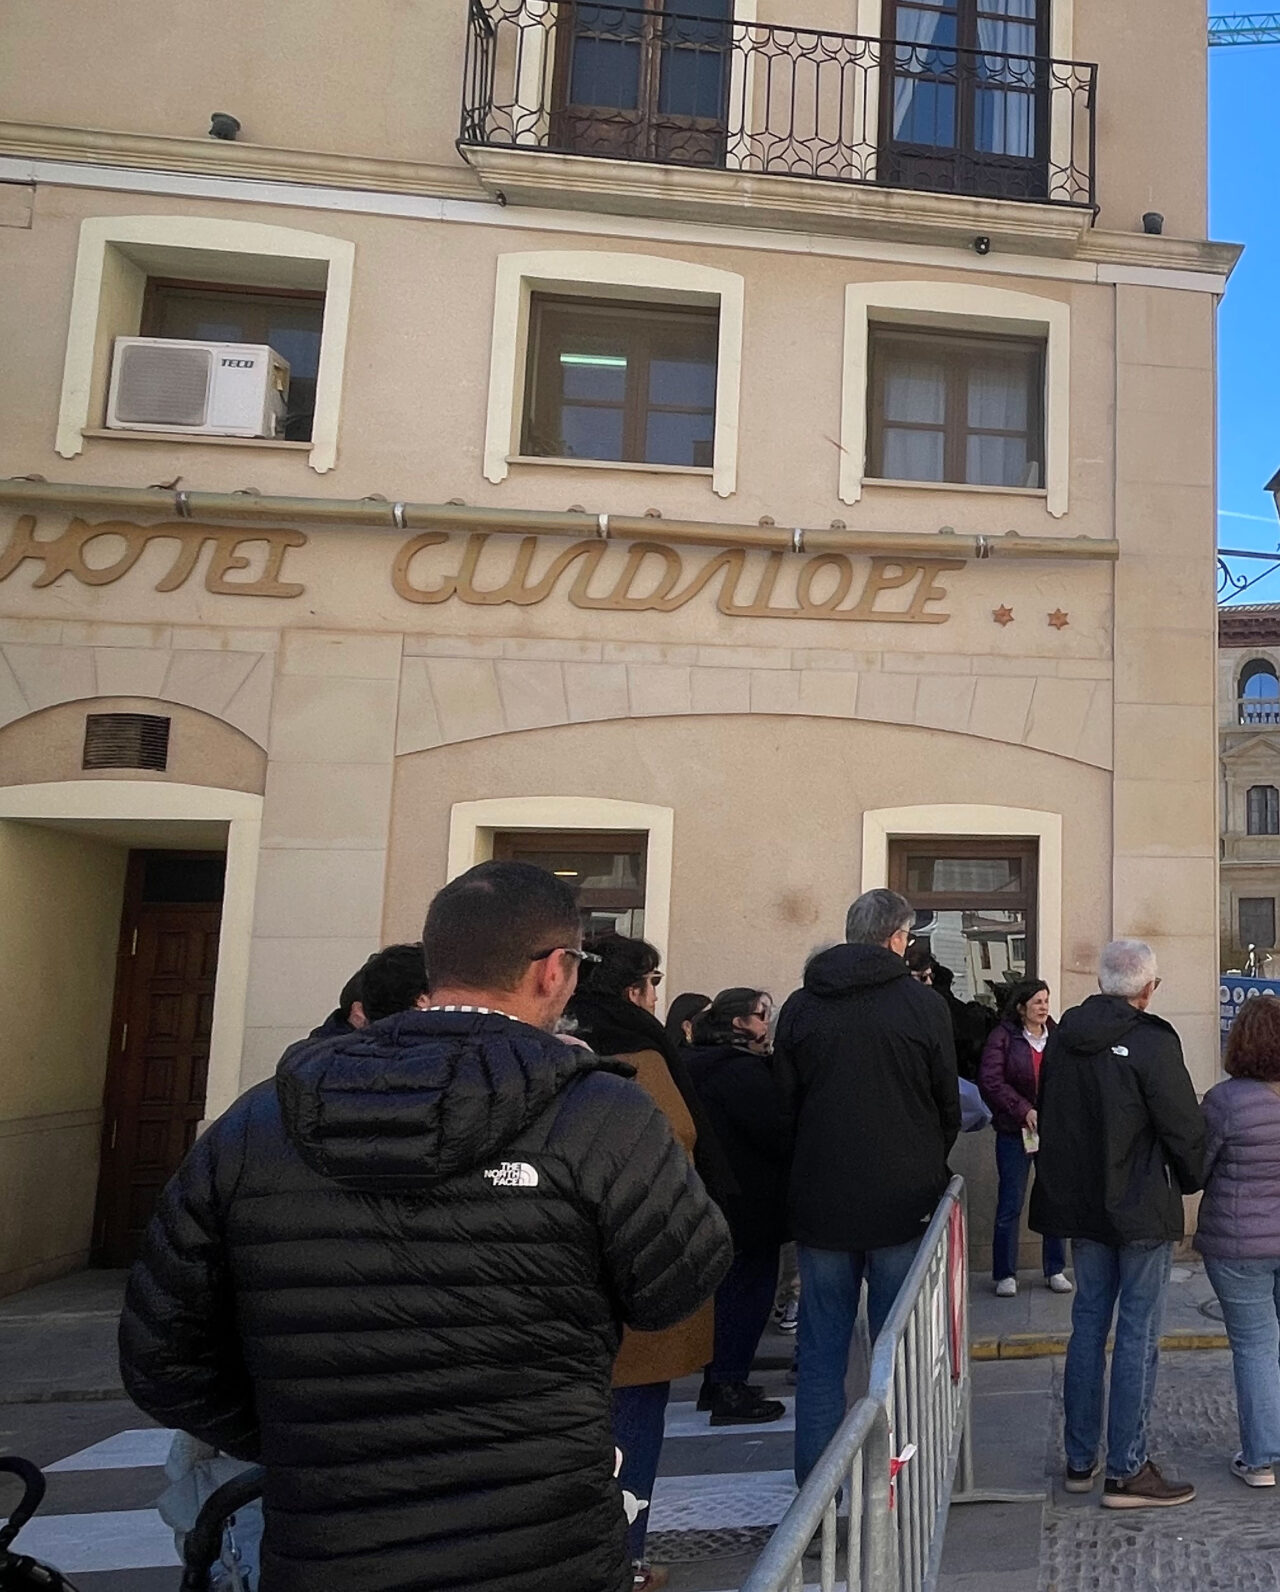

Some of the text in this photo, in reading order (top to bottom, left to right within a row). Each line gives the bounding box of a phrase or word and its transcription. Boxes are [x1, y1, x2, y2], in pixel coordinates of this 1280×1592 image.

[221, 358, 255, 369] TECO
[0, 514, 967, 624] HOTEL GUADALOPE
[501, 1162, 520, 1171] THE
[484, 1169, 520, 1179] NORTH
[493, 1178, 520, 1186] FACE
